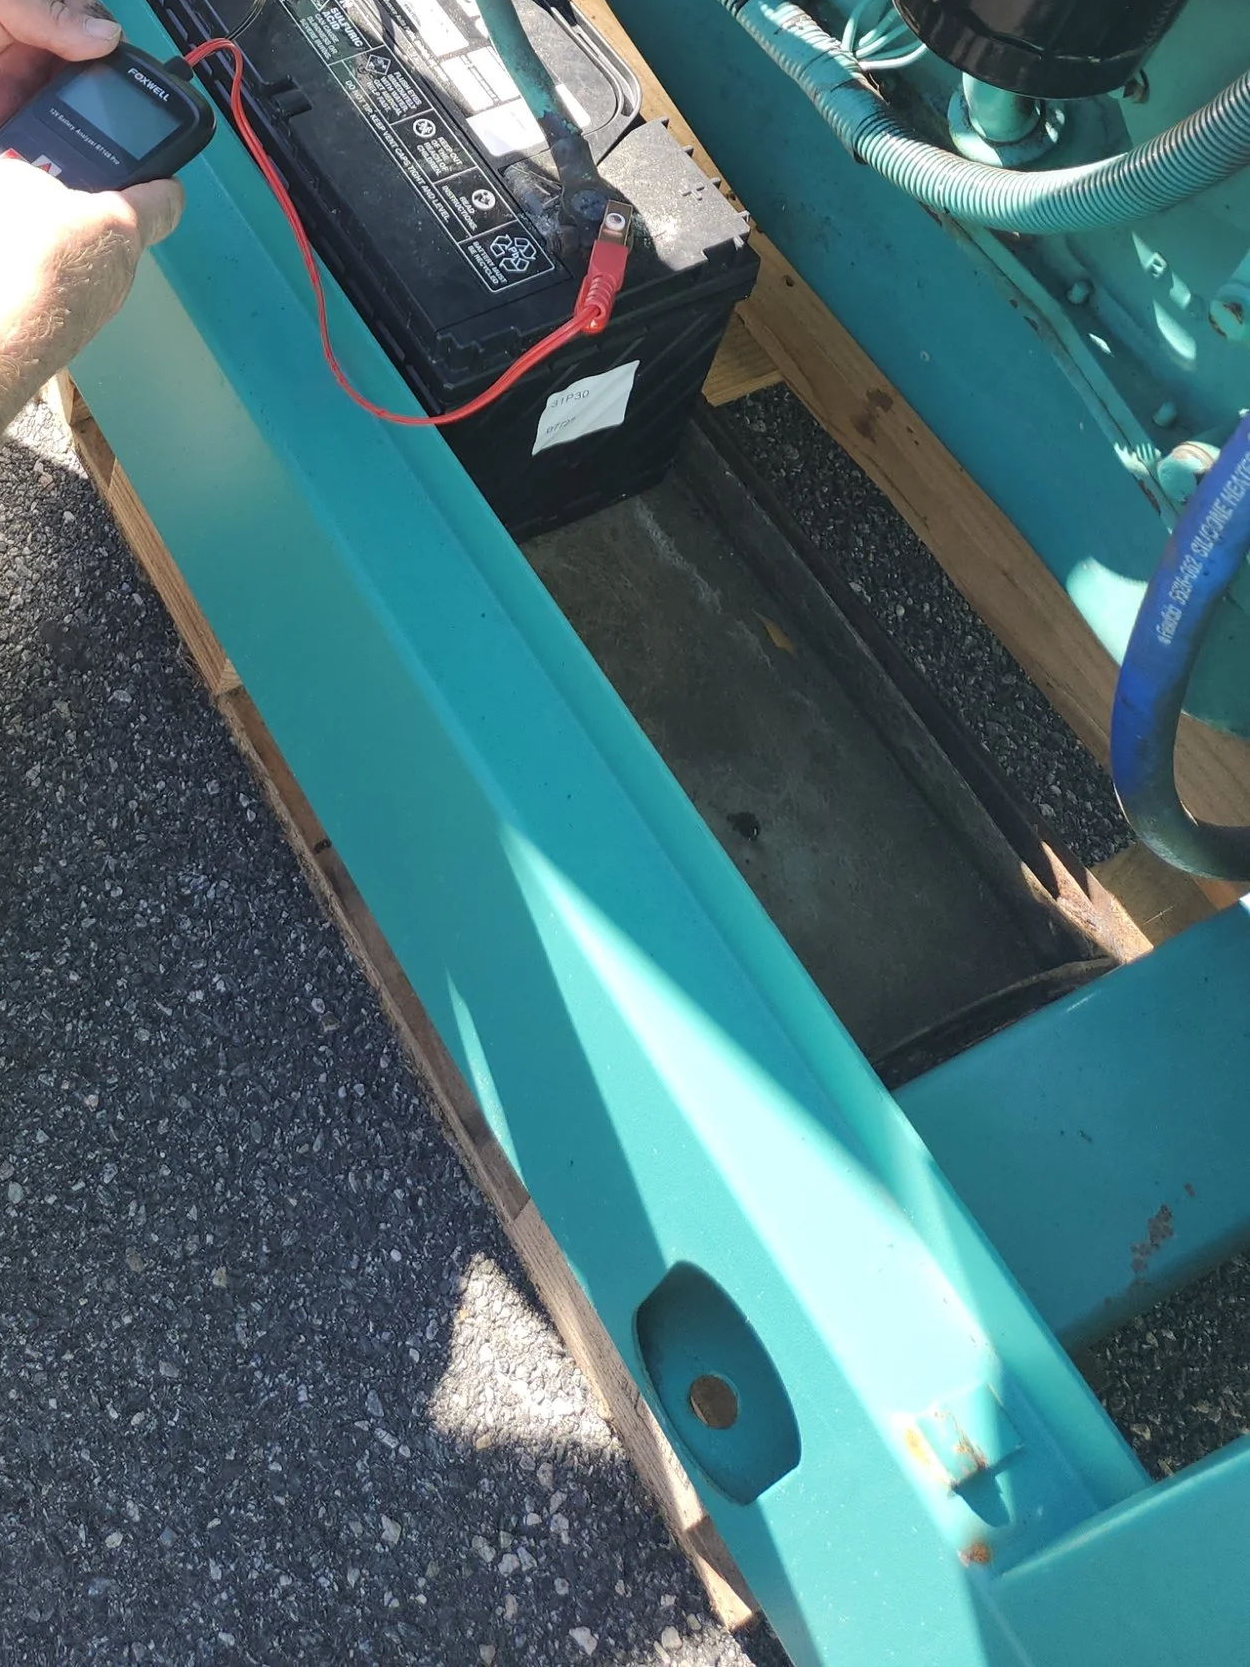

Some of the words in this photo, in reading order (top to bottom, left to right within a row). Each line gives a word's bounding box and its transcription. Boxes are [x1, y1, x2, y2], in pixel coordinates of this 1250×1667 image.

[322, 11, 340, 30] ACID
[331, 8, 363, 47] SULFURIC
[127, 67, 172, 102] FOXWELL
[59, 115, 76, 131] Battery
[467, 245, 476, 254] BE
[473, 241, 496, 269] BATTERY
[493, 267, 508, 284] MUST
[1191, 498, 1233, 558] SILICONE
